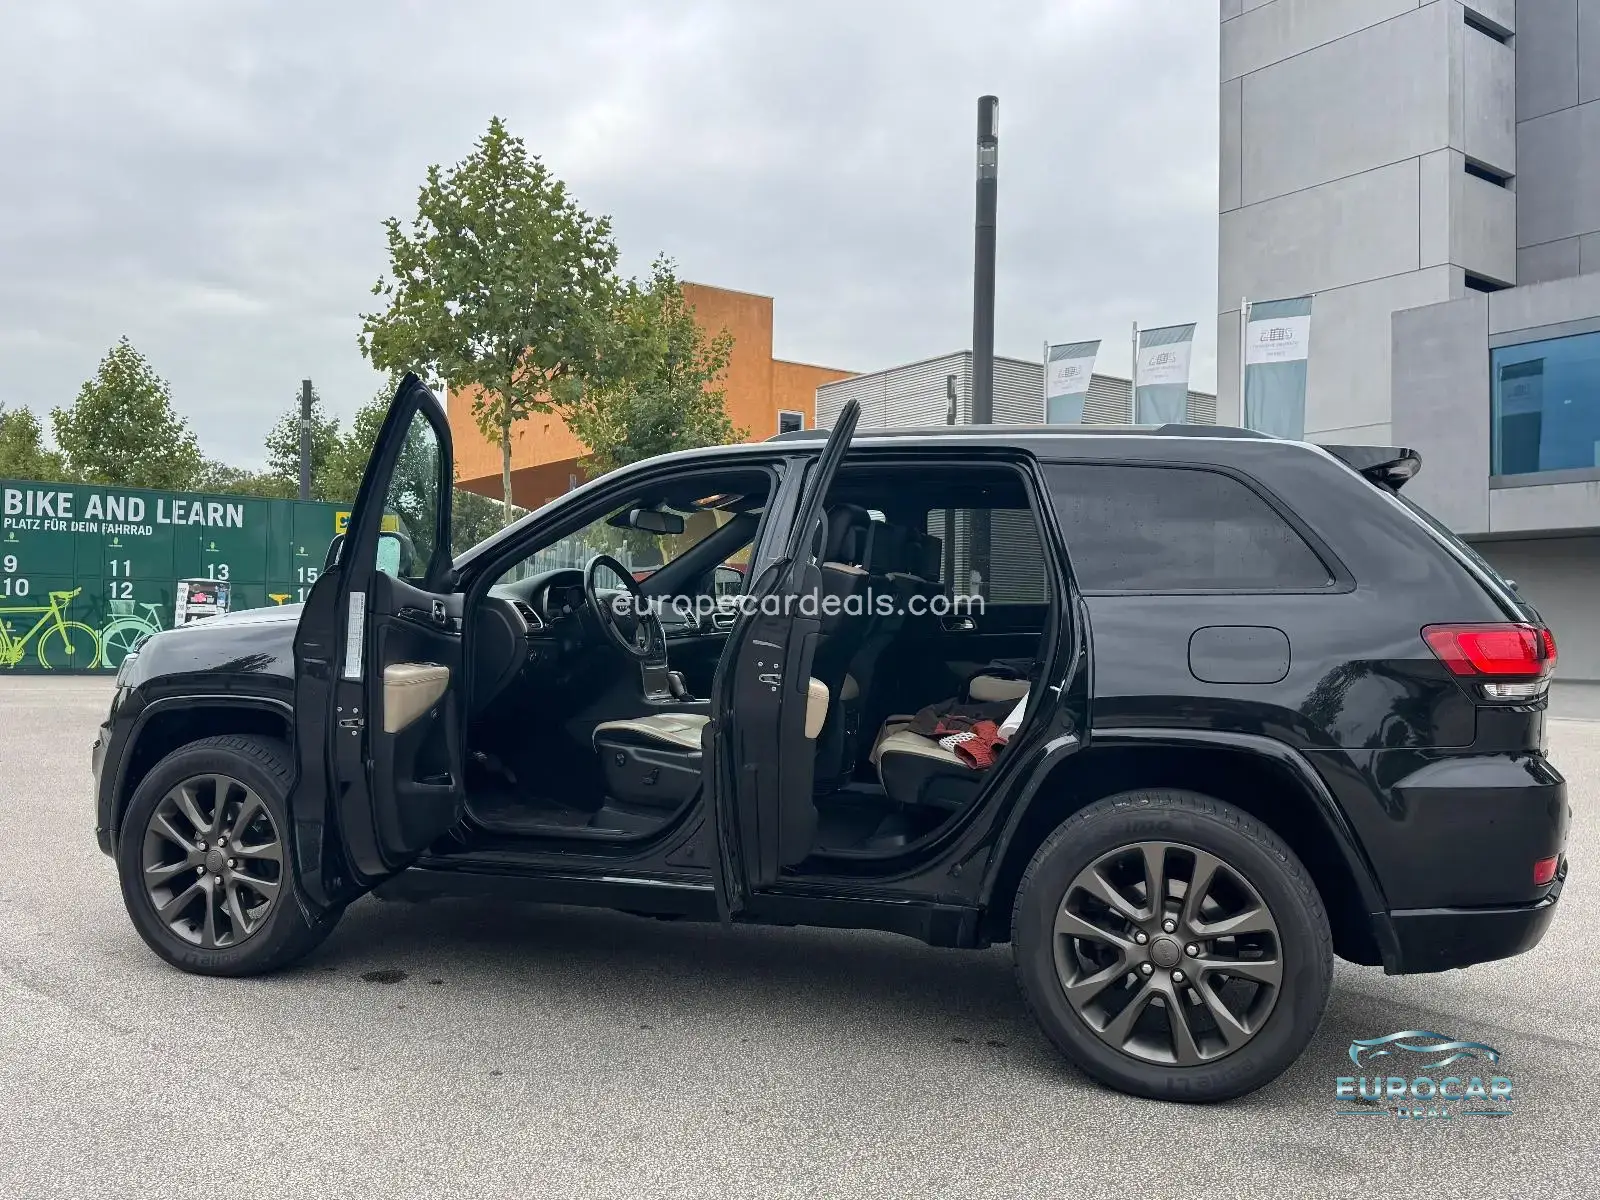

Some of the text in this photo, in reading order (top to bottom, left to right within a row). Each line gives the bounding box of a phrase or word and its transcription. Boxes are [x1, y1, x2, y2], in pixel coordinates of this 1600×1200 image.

[4, 488, 243, 528] BIKE AND LEARN
[3, 517, 153, 536] PLATZ FÜR DEIN FAHRRAD
[3, 554, 18, 573] 9
[110, 560, 131, 577] 11
[208, 564, 229, 580] 13
[298, 567, 318, 584] 15
[3, 578, 29, 597] 10
[109, 581, 133, 599] 12
